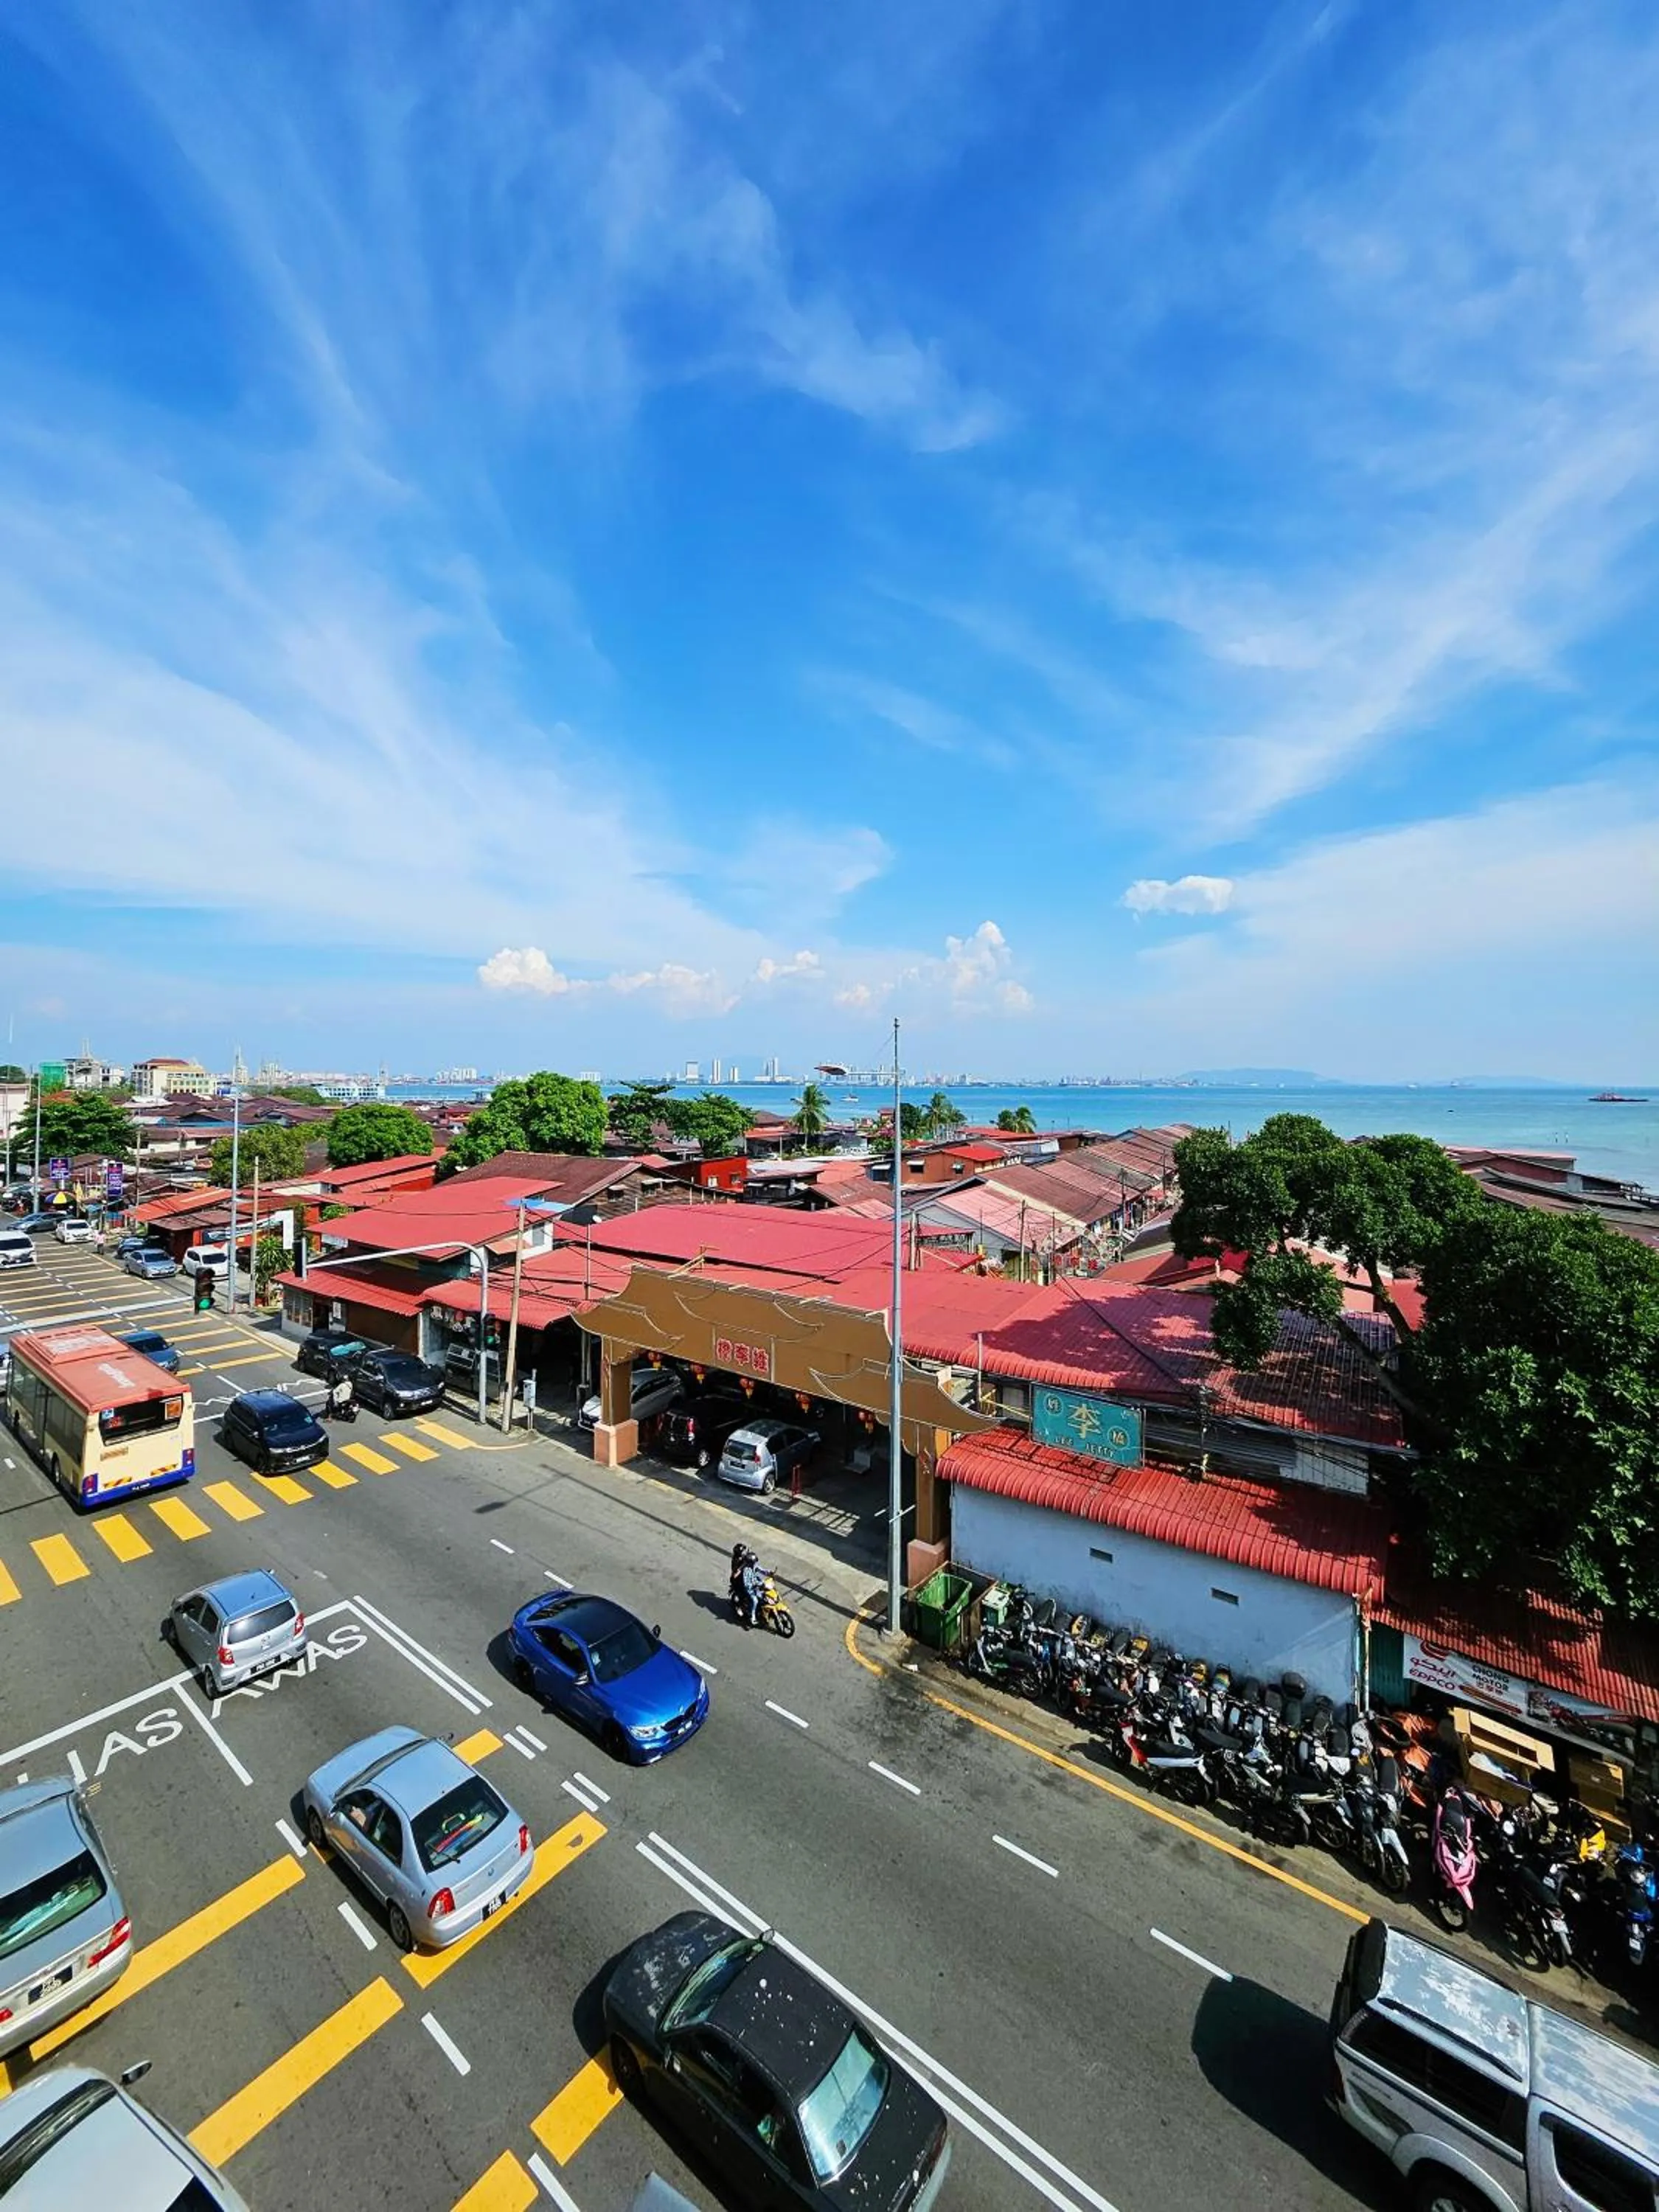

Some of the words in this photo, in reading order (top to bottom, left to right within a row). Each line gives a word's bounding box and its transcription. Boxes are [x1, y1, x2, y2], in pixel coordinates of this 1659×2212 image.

[1067, 1403, 1102, 1439] 李
[1055, 1436, 1074, 1445] LEE
[1085, 1442, 1114, 1458] JETTY
[1472, 1673, 1509, 1691] MOTOR
